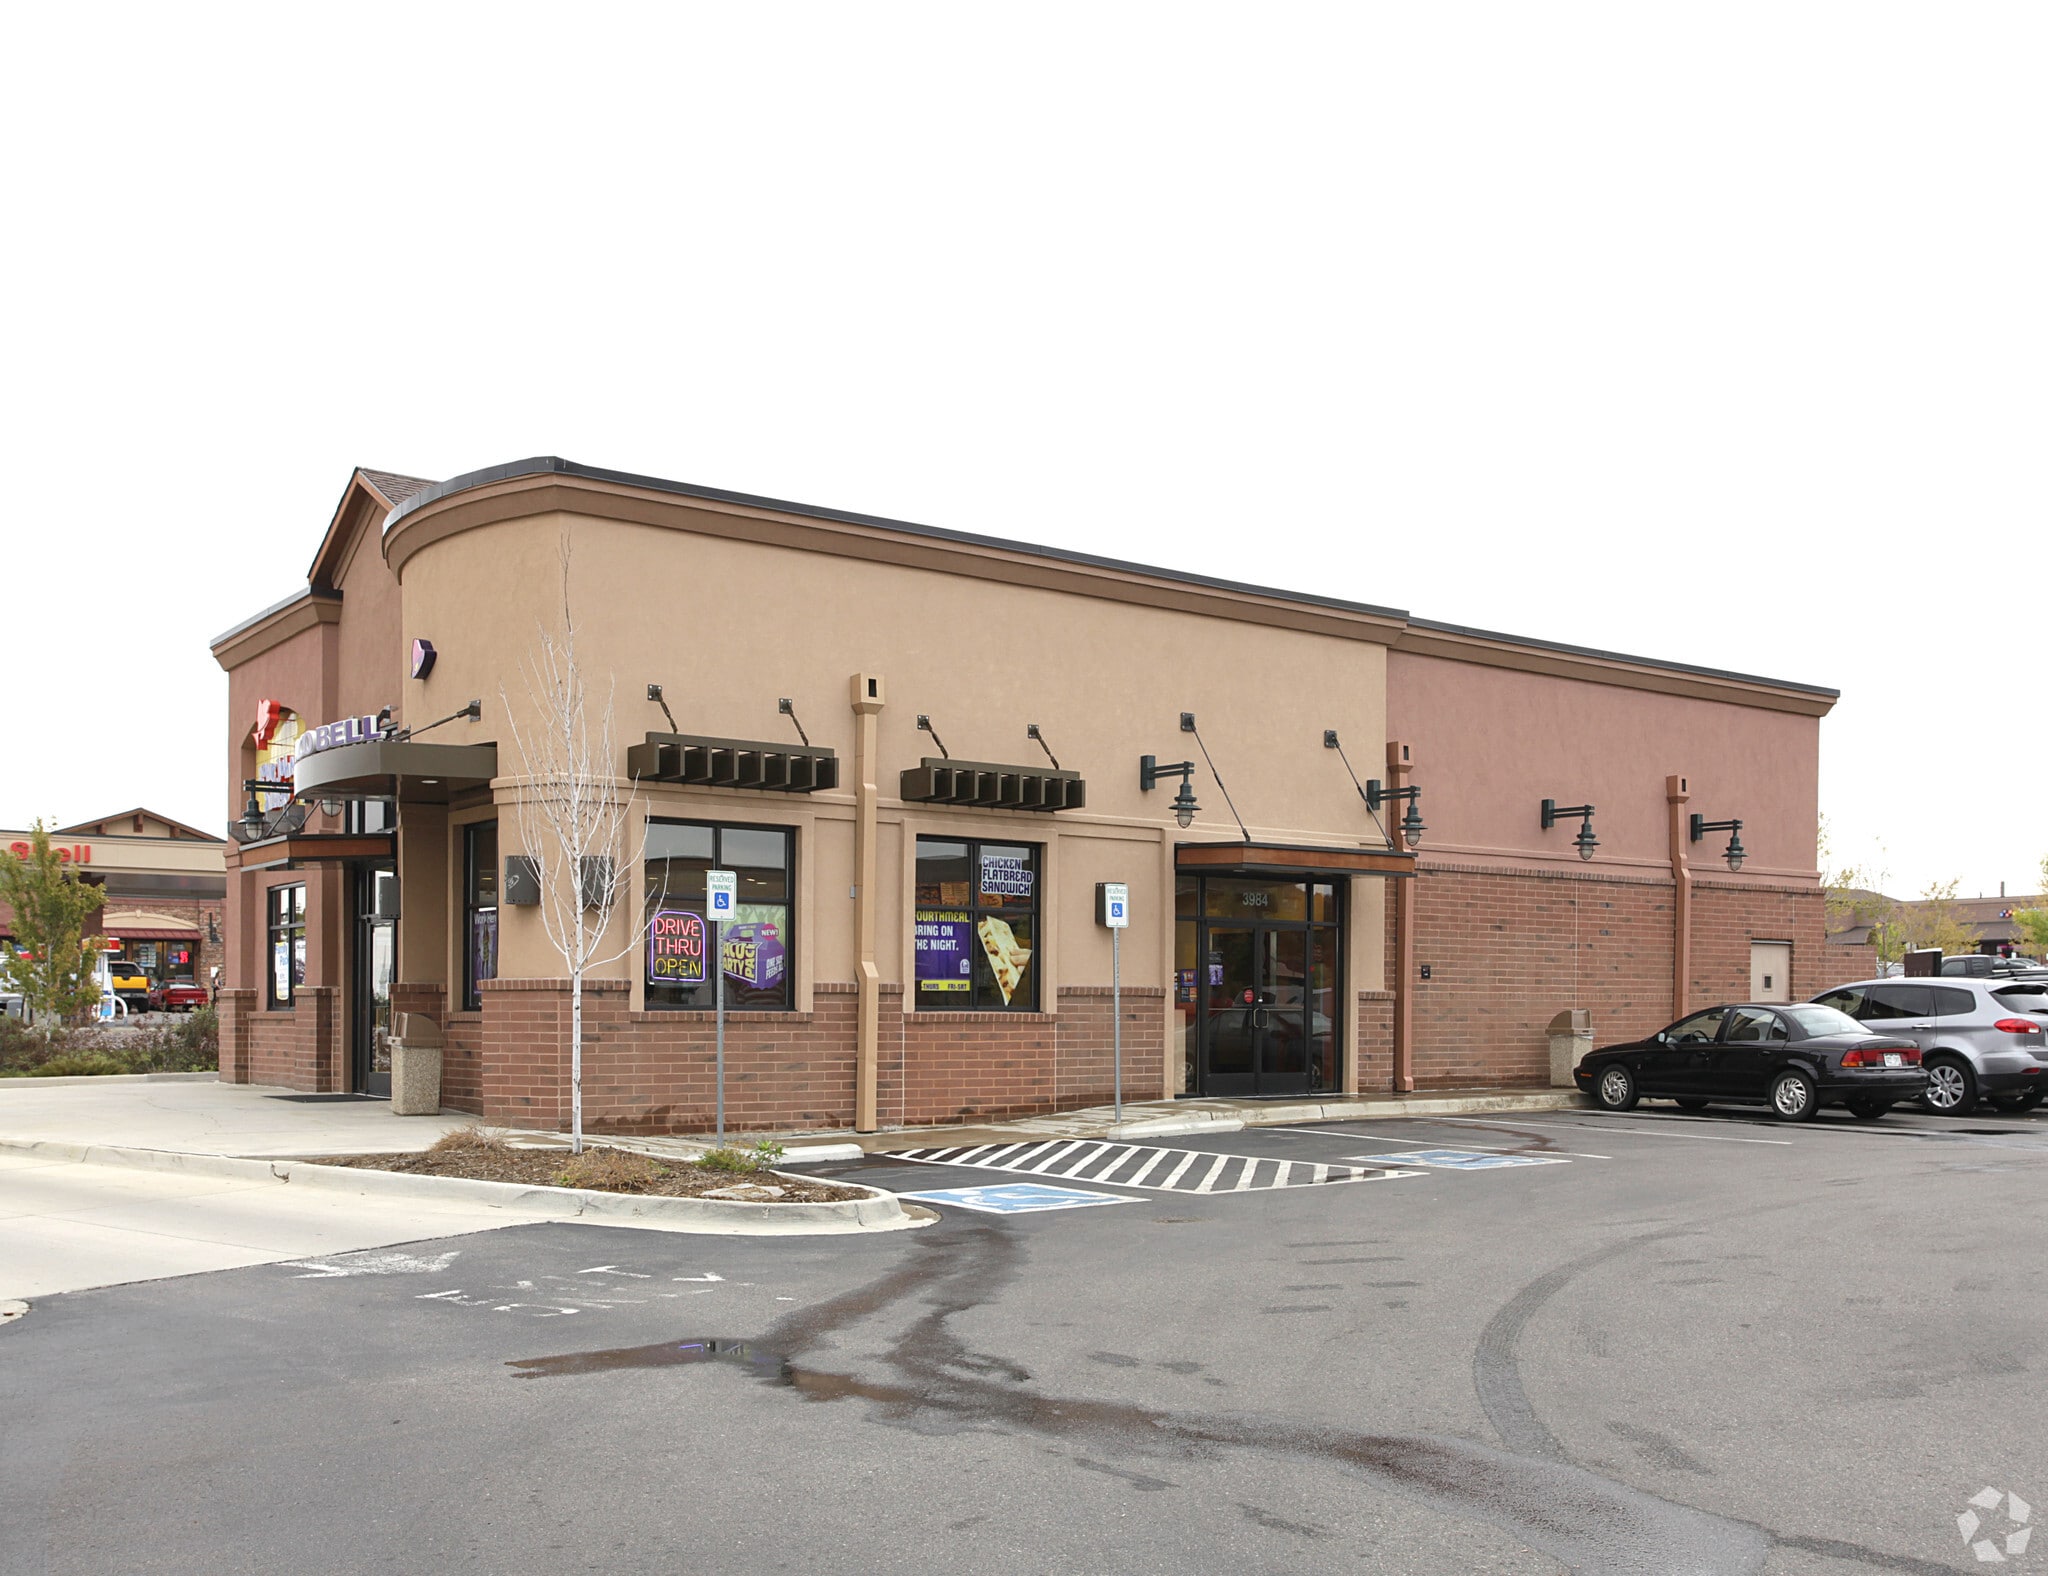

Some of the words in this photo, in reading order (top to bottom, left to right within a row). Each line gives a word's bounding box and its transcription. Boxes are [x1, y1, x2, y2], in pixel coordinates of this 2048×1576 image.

[315, 715, 385, 751] BELL
[982, 857, 1022, 870] CHICKEN
[982, 869, 1033, 883] FLATBREAD
[982, 881, 1030, 895] SANDWICH
[1243, 892, 1268, 906] 3984
[915, 911, 970, 923] OURTHMEAL
[654, 918, 701, 937] DRIVE
[940, 925, 954, 937] ON
[655, 937, 701, 956] THRU
[723, 942, 747, 960] ACO
[930, 939, 960, 951] NIGHT.
[655, 958, 701, 977] OPEN
[723, 957, 745, 976] ARTY
